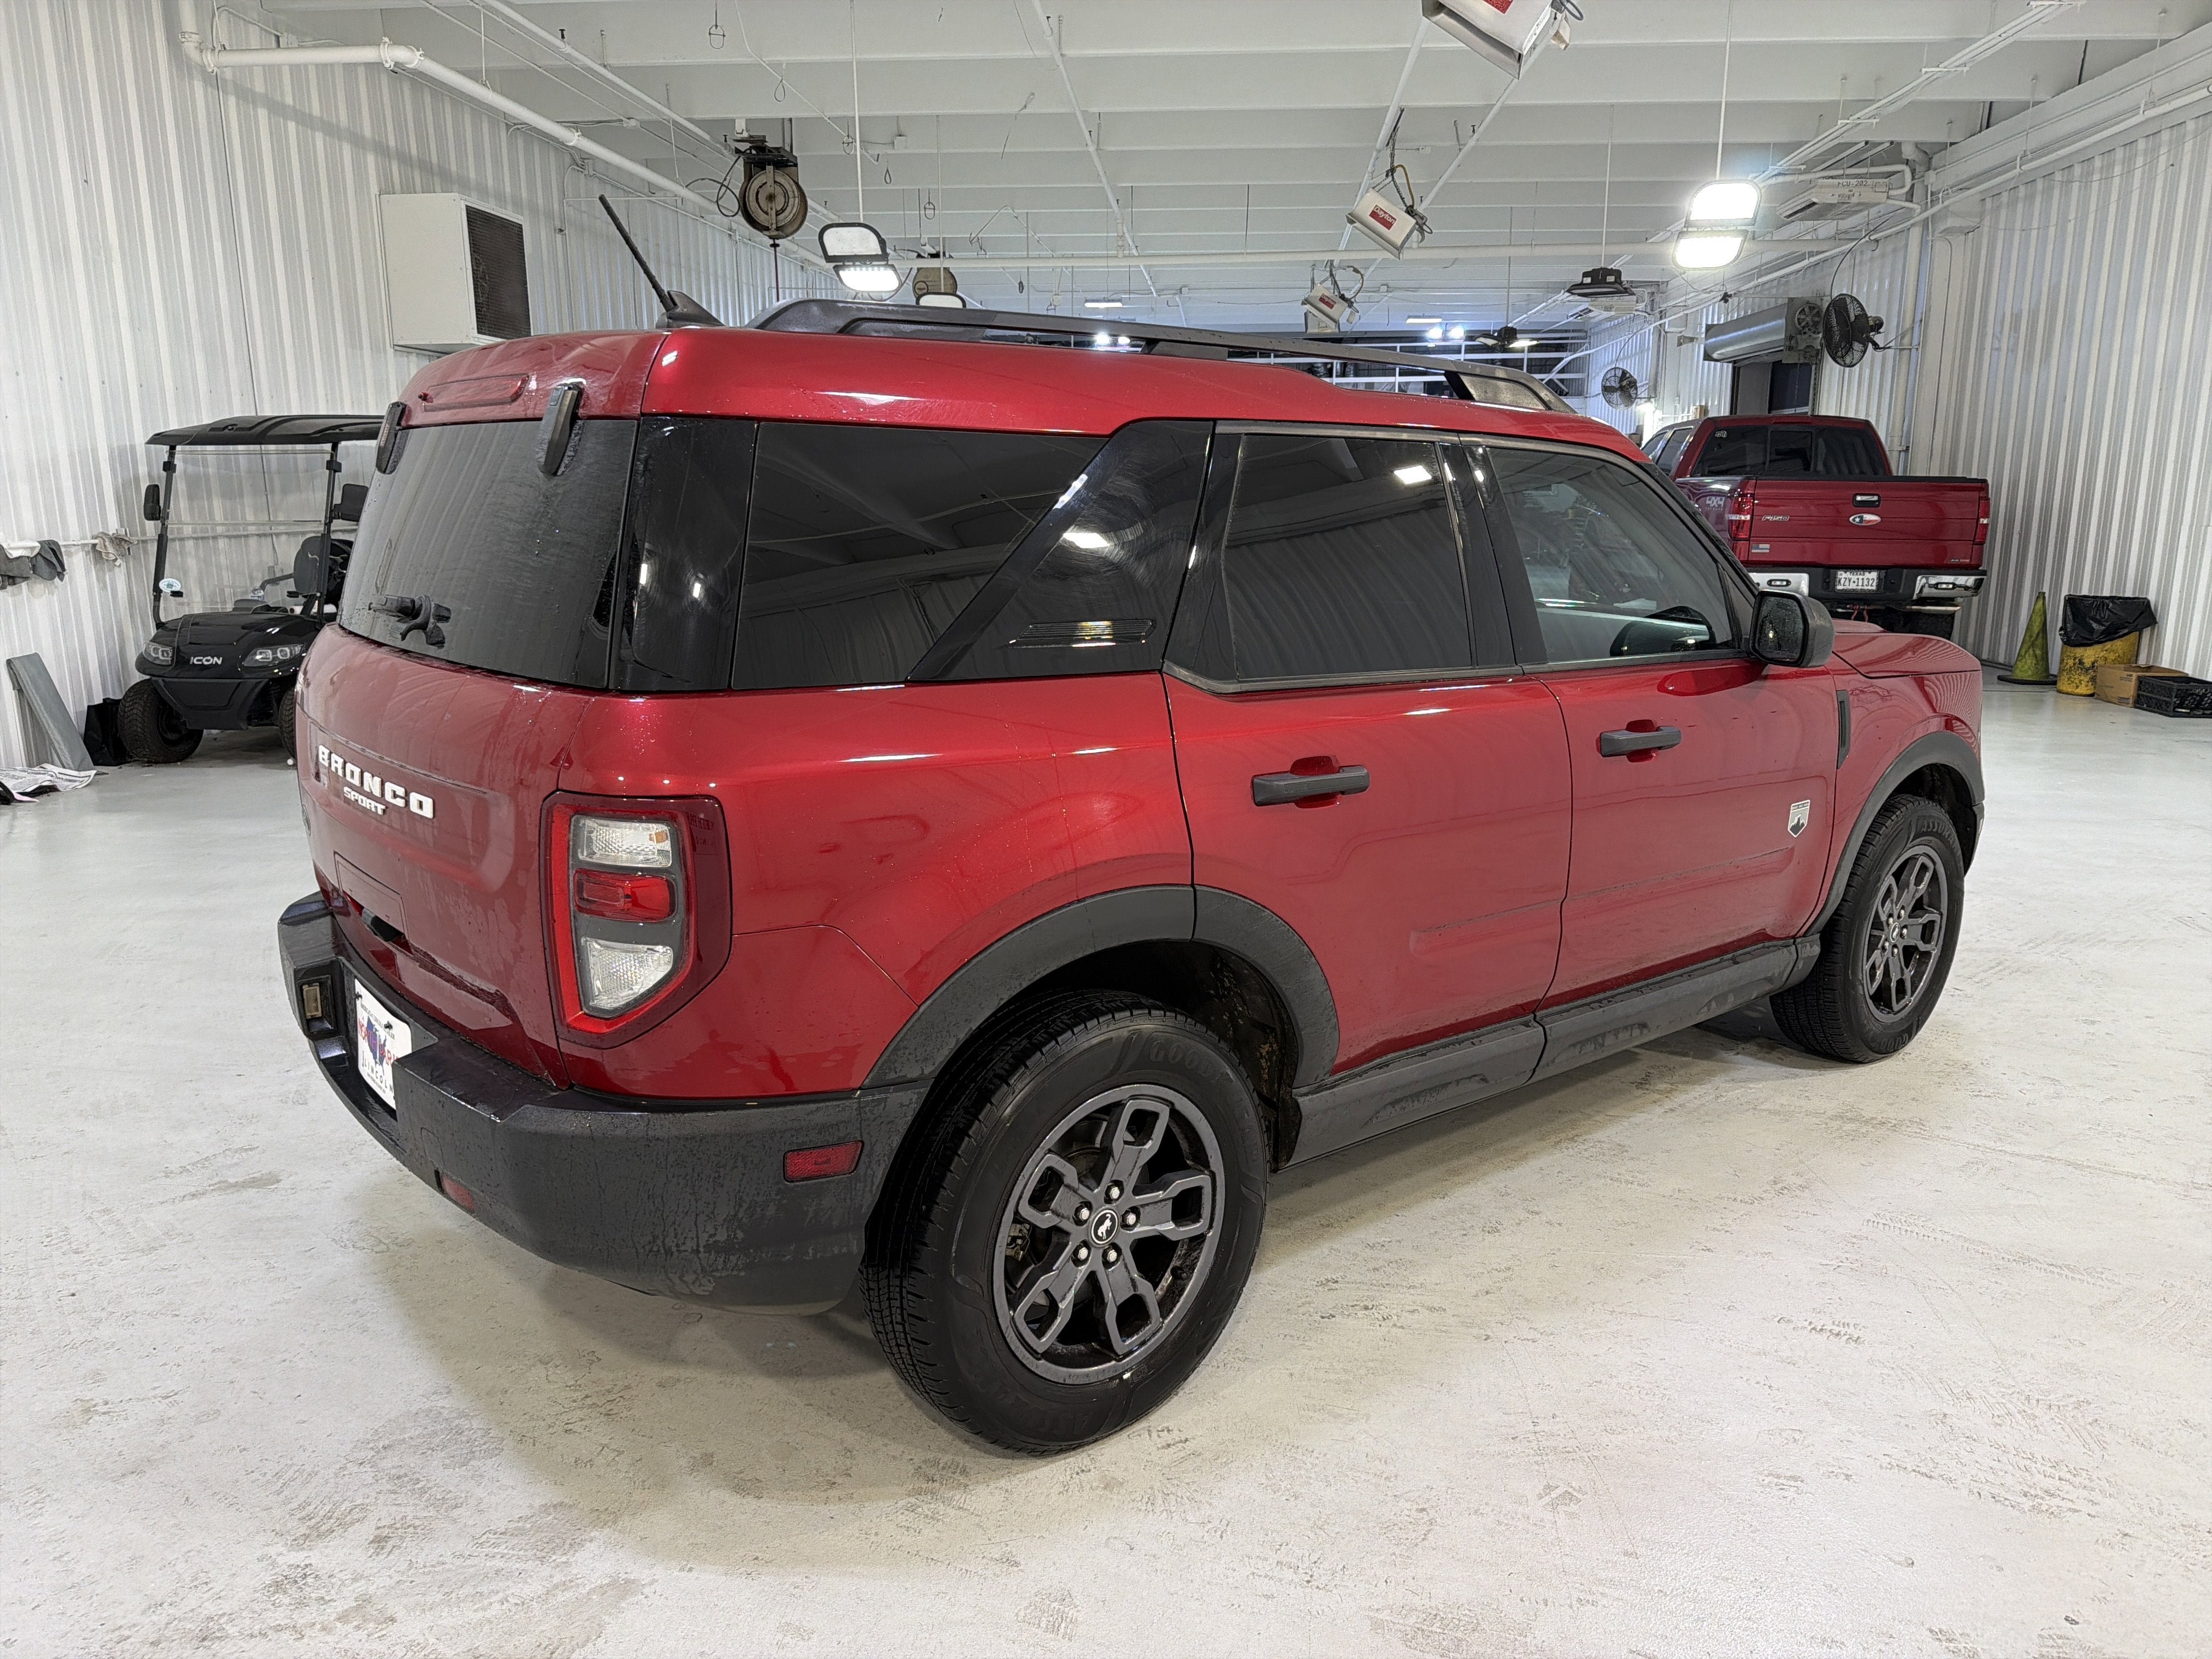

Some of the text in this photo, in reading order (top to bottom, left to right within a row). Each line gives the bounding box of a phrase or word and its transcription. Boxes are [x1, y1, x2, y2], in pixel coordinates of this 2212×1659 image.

[1374, 206, 1396, 224] Dayton
[1321, 294, 1336, 306] Dayton
[190, 656, 222, 665] ICON
[319, 744, 435, 819] BRONCO
[343, 786, 386, 816] SPORT
[364, 1057, 393, 1093] LINCOLN
